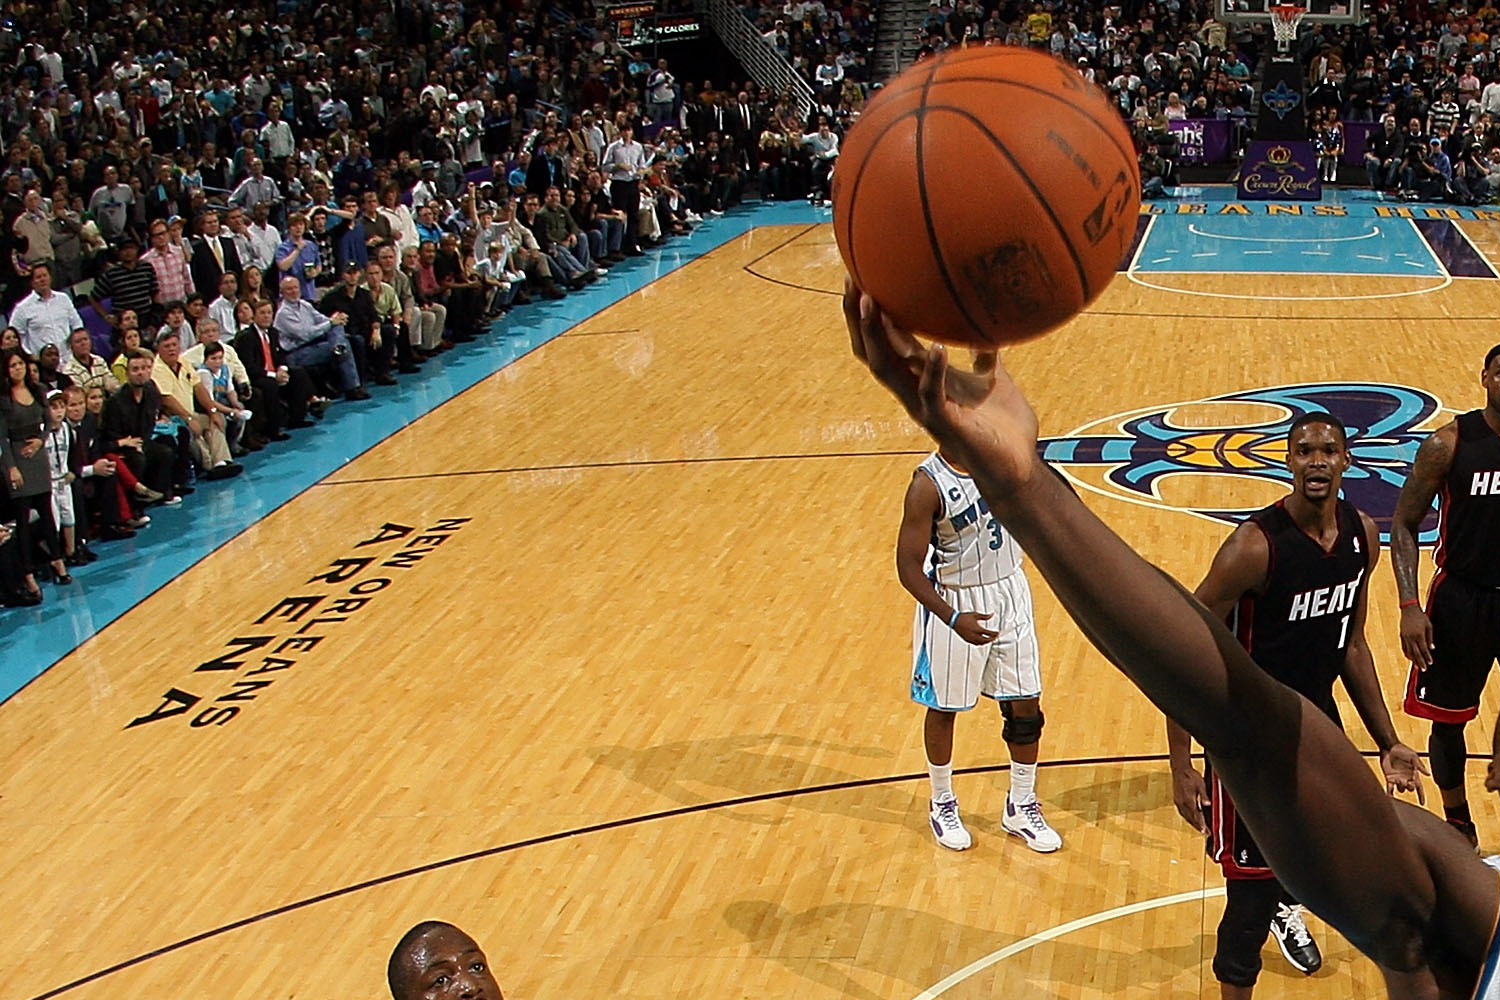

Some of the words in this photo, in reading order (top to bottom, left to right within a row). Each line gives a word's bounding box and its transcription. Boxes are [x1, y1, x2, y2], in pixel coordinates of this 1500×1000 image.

[664, 23, 700, 34] CALORIES
[1243, 173, 1279, 194] Crown
[1271, 174, 1317, 196] Royal
[1138, 203, 1348, 216] LEANS
[949, 487, 961, 502] C
[381, 517, 473, 569] NEW
[987, 517, 1003, 550] 3
[1288, 567, 1364, 622] HEAT
[123, 522, 415, 730] ARENA
[1338, 614, 1350, 650] 1
[190, 577, 392, 728] ORLEANS
